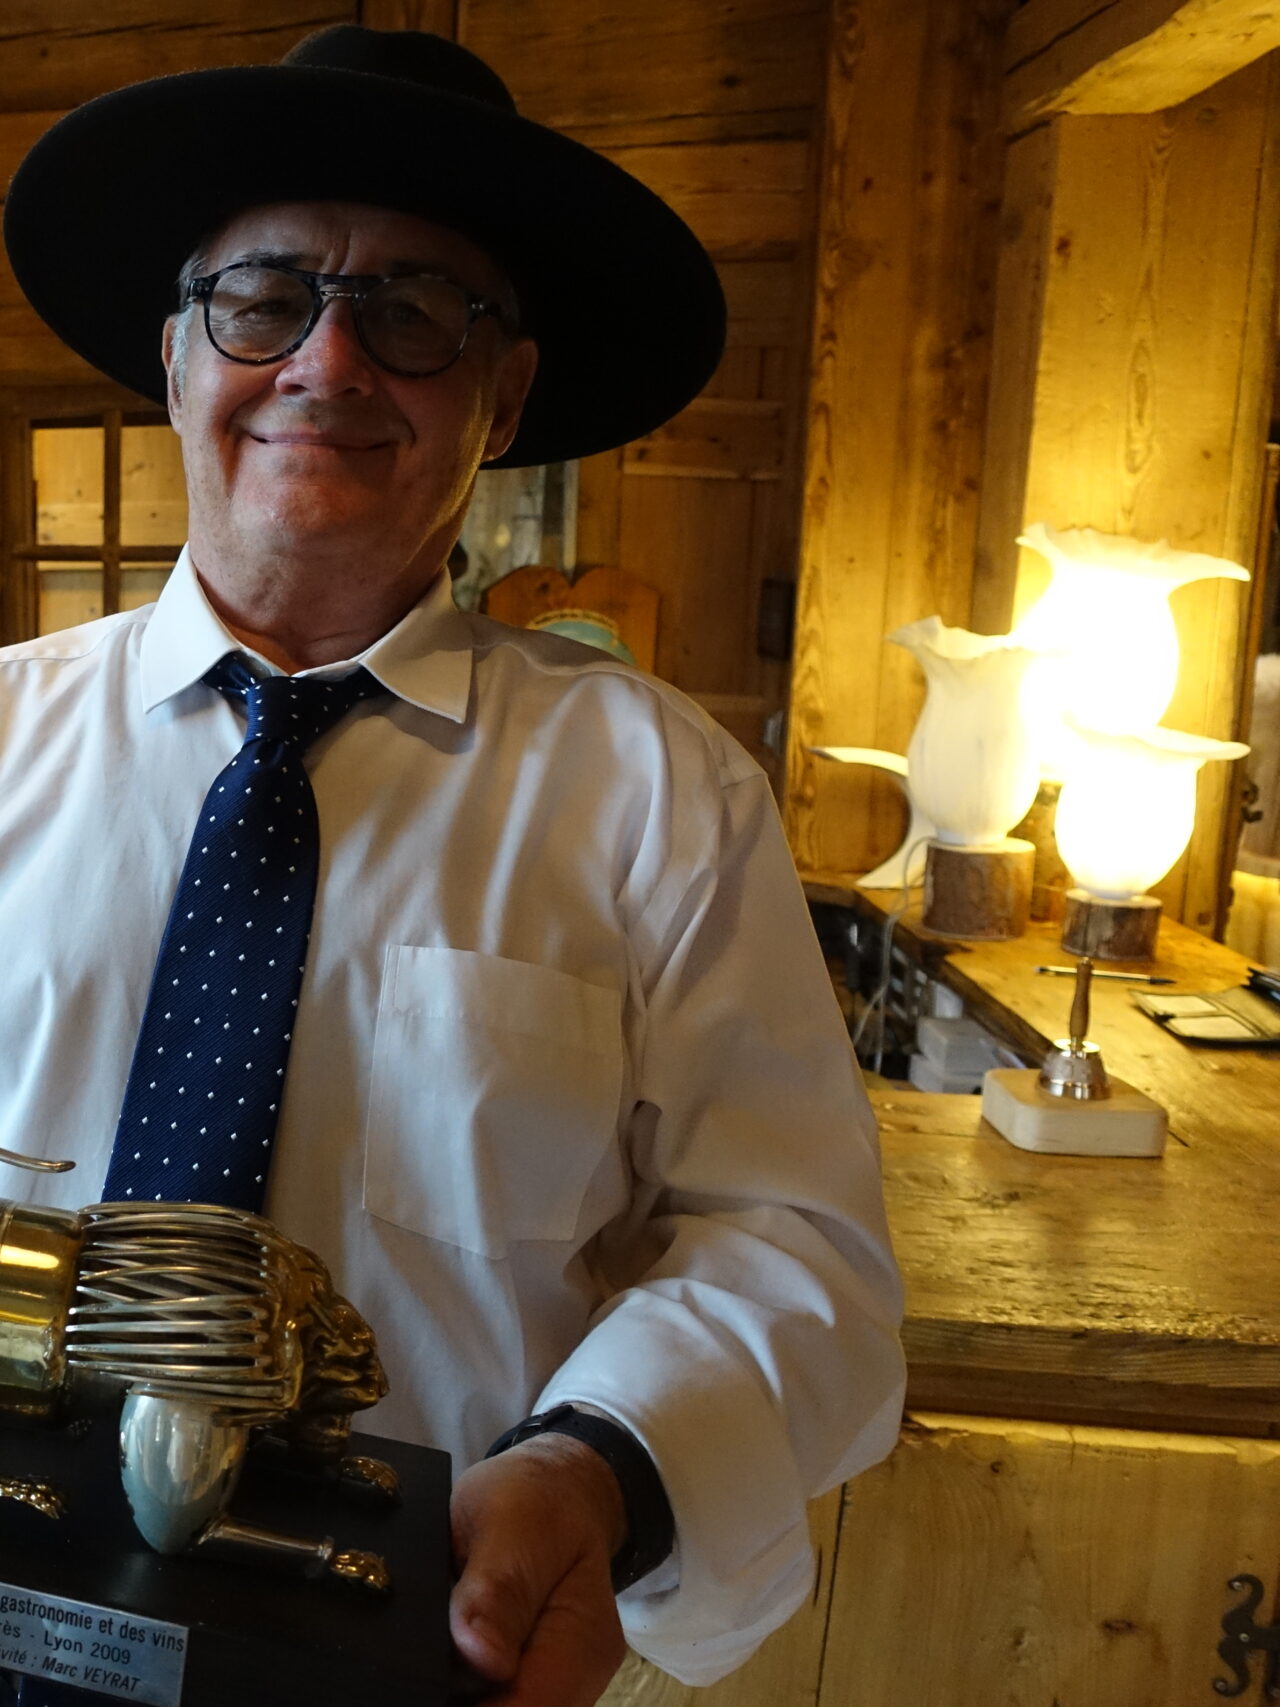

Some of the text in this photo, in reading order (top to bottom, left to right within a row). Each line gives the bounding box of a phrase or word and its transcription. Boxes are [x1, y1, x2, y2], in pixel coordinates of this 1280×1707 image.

[0, 1594, 93, 1629] gastronomie
[98, 1616, 114, 1636] et
[120, 1621, 146, 1643] des
[152, 1630, 185, 1652] vins
[43, 1630, 83, 1654] Lyon
[90, 1641, 131, 1665] 2009
[42, 1656, 77, 1678] Marc
[84, 1666, 140, 1692] VEYRAT
